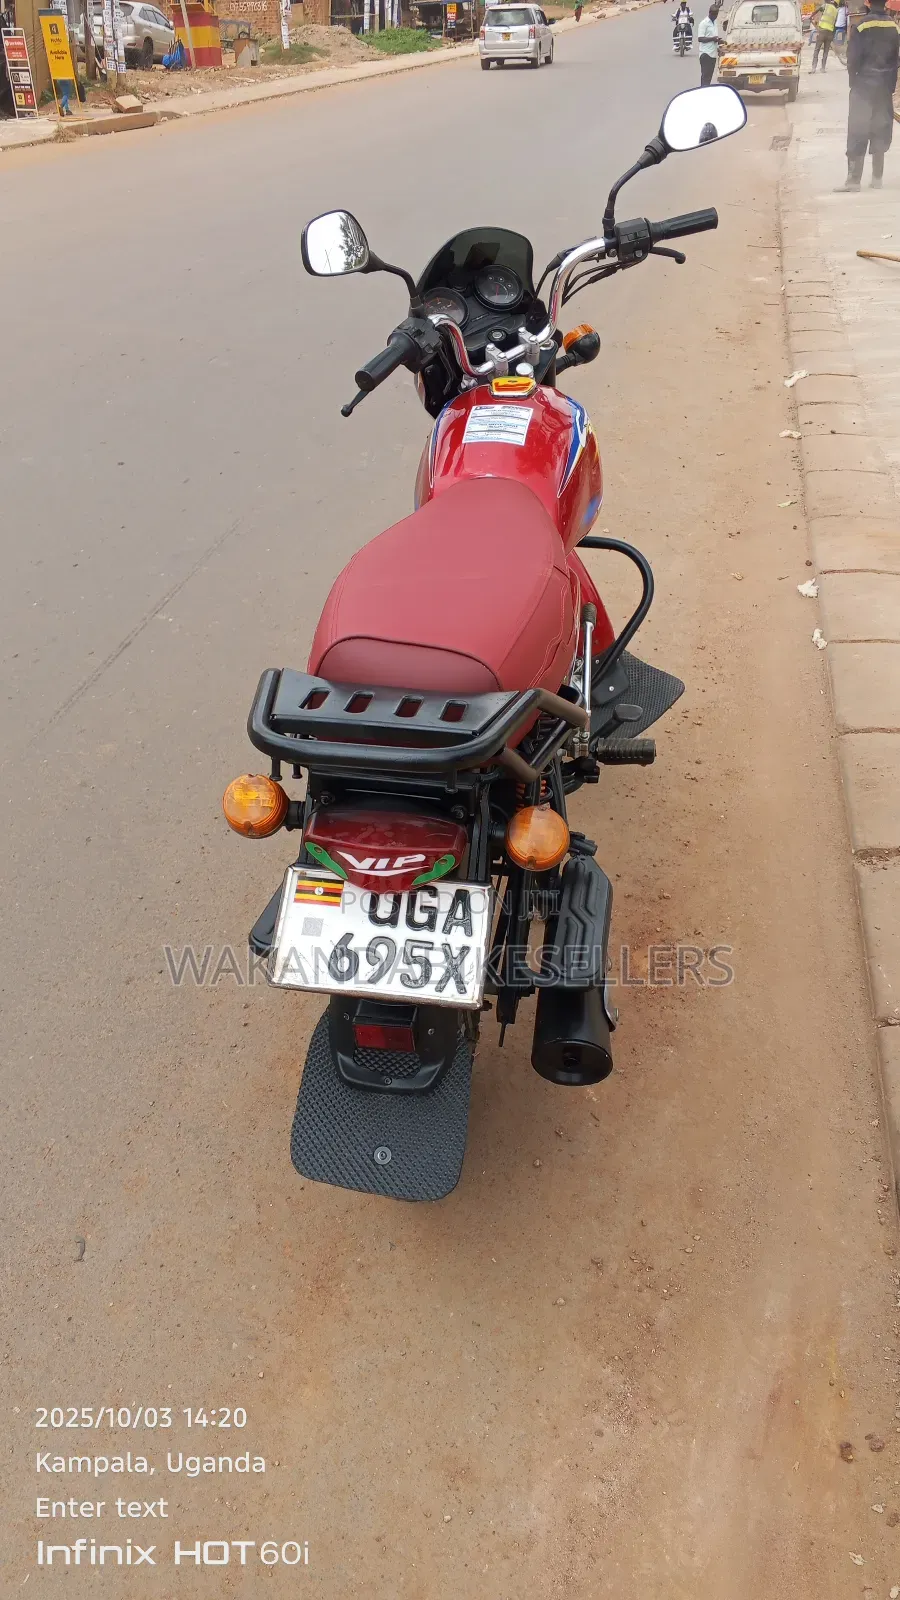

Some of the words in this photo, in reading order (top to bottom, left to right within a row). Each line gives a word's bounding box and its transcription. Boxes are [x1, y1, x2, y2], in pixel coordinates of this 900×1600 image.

[337, 850, 426, 870] VIP
[368, 885, 473, 938] UGA
[328, 932, 471, 994] 695X
